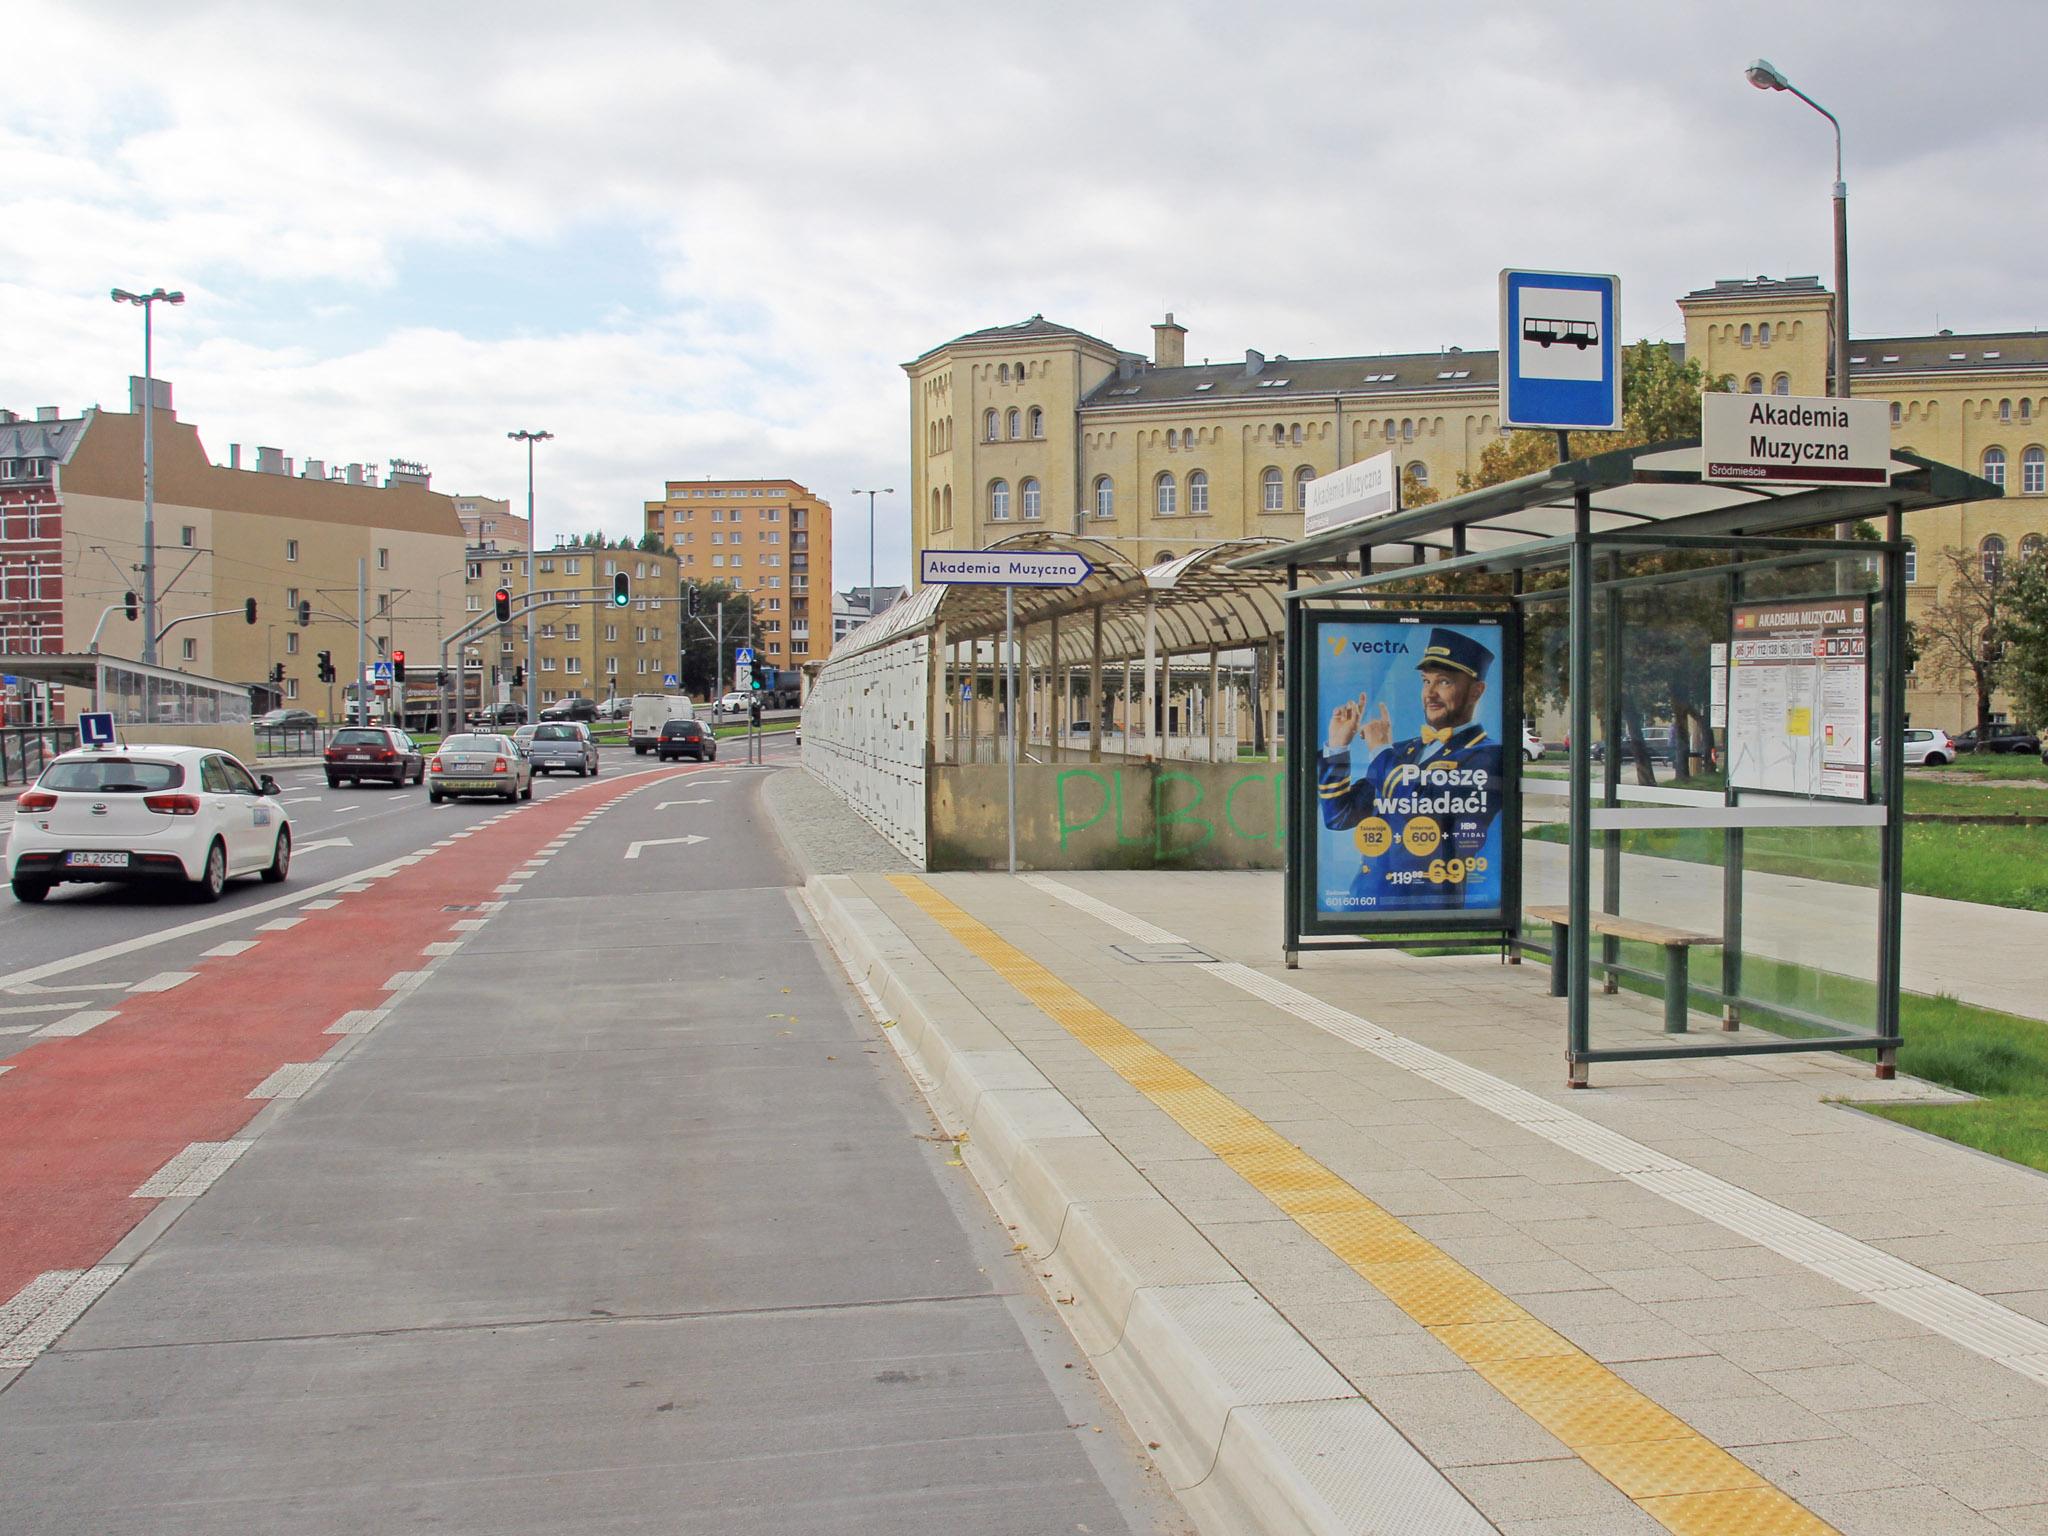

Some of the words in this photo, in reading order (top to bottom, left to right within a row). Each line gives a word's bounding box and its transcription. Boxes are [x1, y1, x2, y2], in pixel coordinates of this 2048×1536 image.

[1750, 402, 1849, 428] Akademia
[1750, 436, 1849, 464] Muzyczna
[1711, 464, 1767, 477] Śródmieście
[929, 561, 1000, 574] Akademia
[1009, 562, 1076, 577] Muzyczna
[1759, 612, 1800, 627] AKADEMIA
[1801, 609, 1846, 625] MUZYCZNA
[90, 719, 108, 739] L
[1402, 764, 1488, 791] Proszę
[1376, 791, 1488, 815] wsiadać!
[1363, 832, 1383, 843] 182
[1411, 831, 1437, 843] 600
[73, 853, 90, 864] GA
[93, 853, 128, 864] 265CC
[1343, 896, 1359, 906] 601
[1360, 896, 1376, 906] 601
